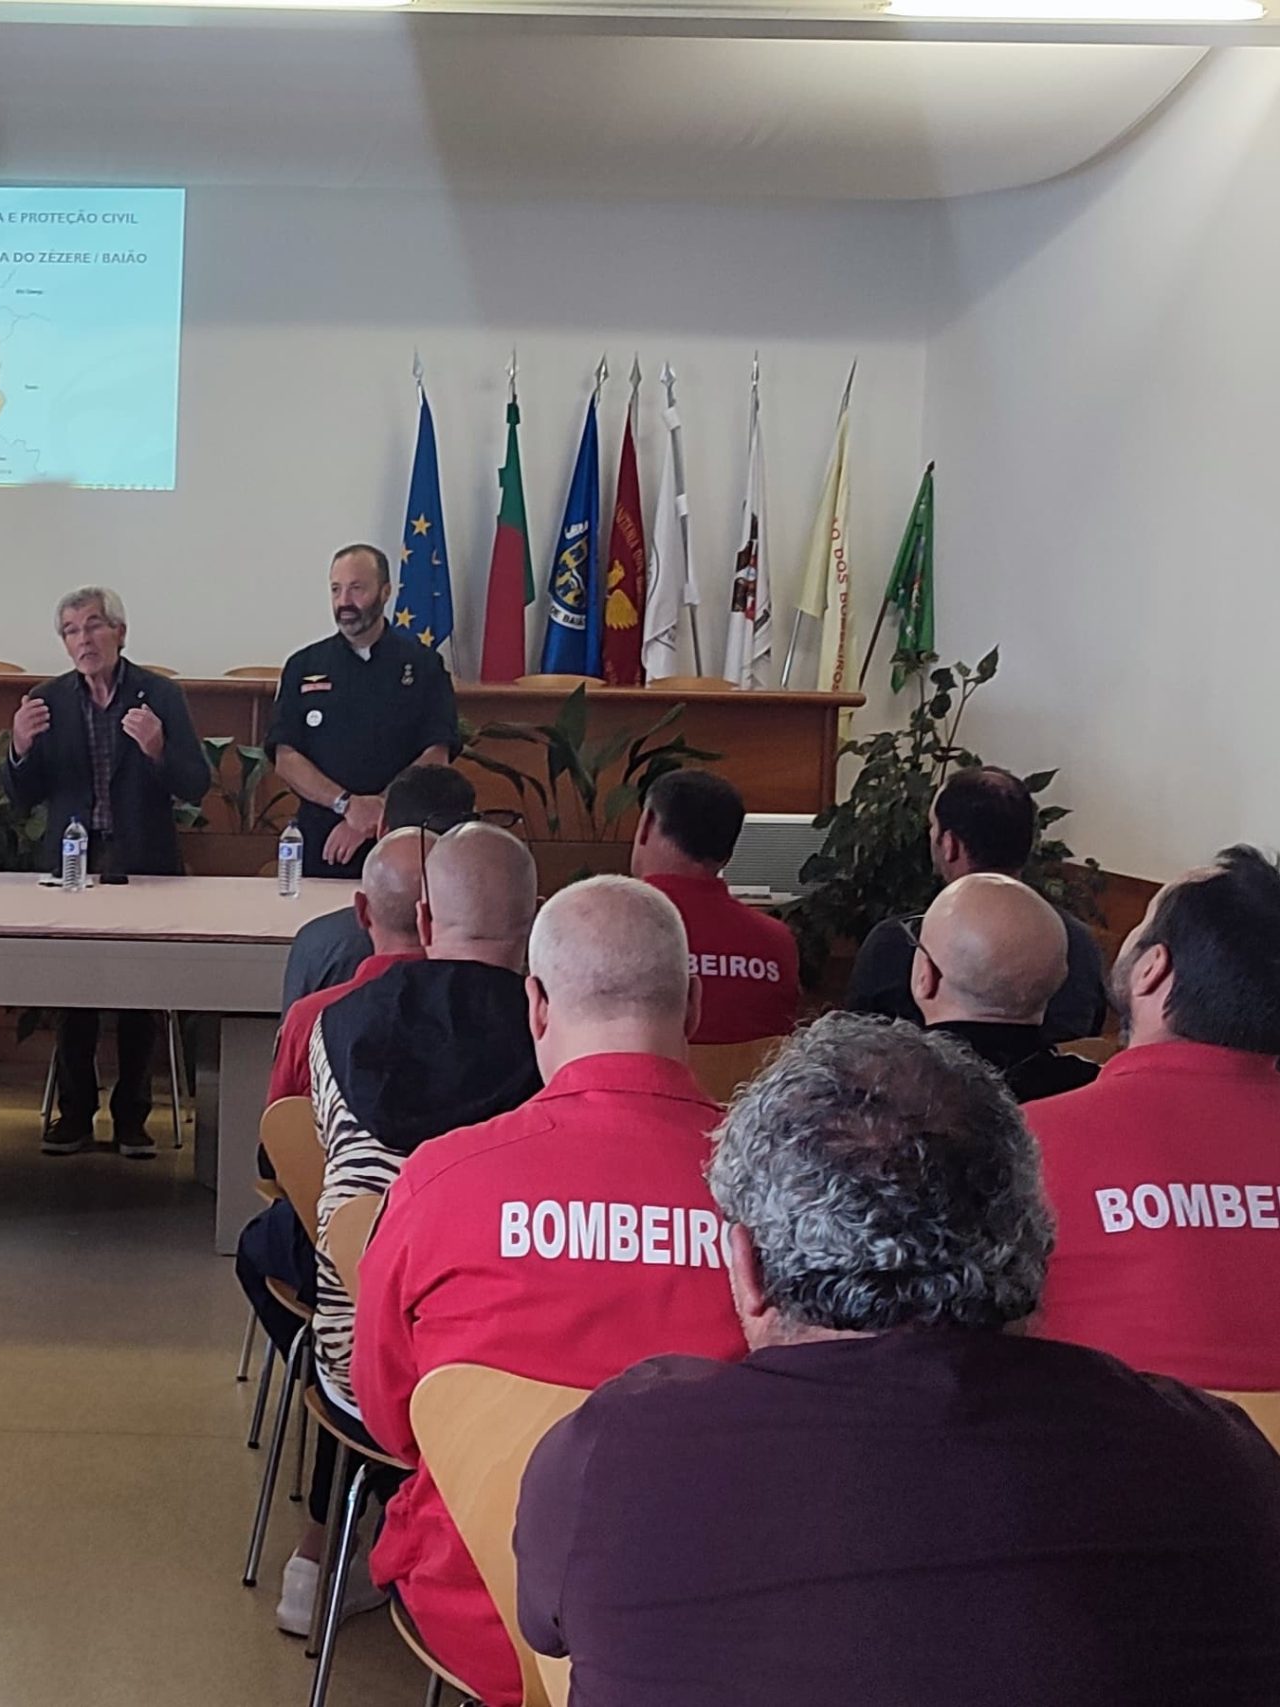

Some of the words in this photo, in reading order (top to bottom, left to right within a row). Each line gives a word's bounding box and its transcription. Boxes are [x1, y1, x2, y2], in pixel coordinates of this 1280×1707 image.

[8, 212, 16, 223] E
[20, 209, 98, 225] PROTEÇÃO
[101, 212, 138, 224] CIVIL
[13, 252, 35, 263] DO
[102, 249, 147, 264] BAIÃO
[833, 548, 849, 585] DOS
[1095, 1183, 1280, 1233] BOMBE
